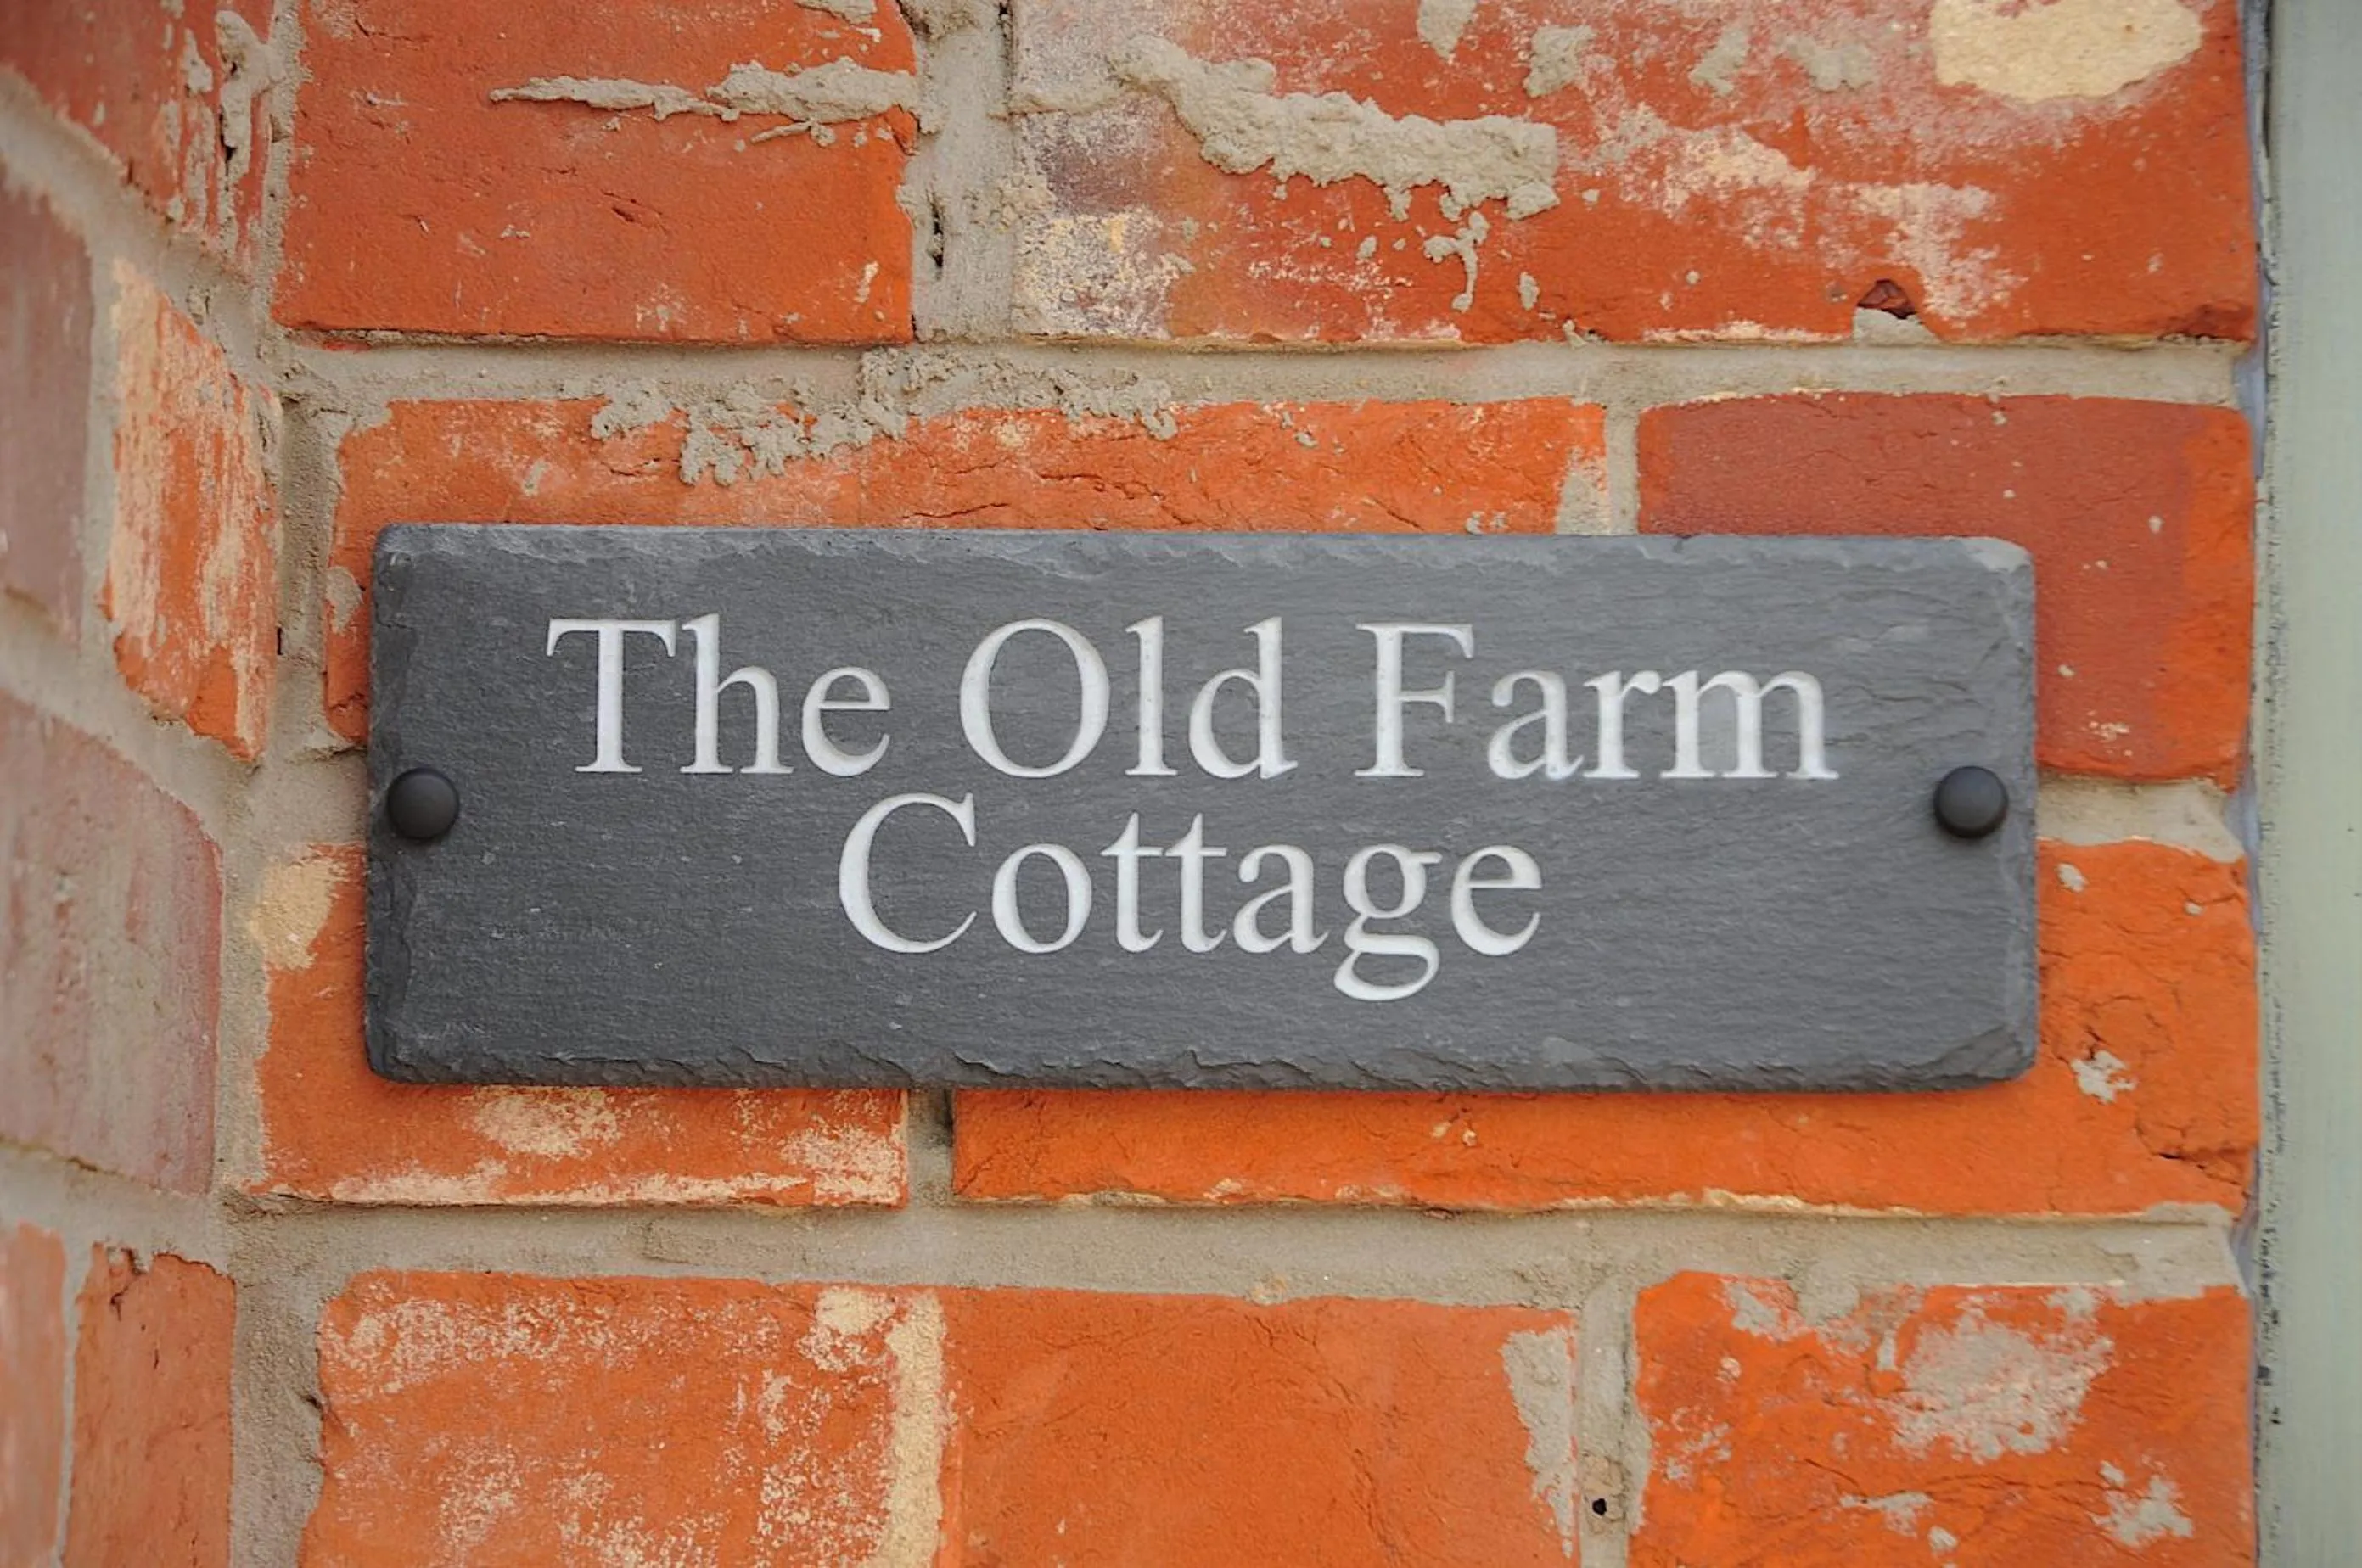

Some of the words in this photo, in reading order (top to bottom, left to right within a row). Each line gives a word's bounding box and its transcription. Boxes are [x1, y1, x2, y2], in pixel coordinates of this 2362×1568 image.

[545, 614, 891, 778] The
[958, 615, 1299, 781] Old
[1354, 621, 1840, 781] Farm
[837, 791, 1543, 1002] Cottage
